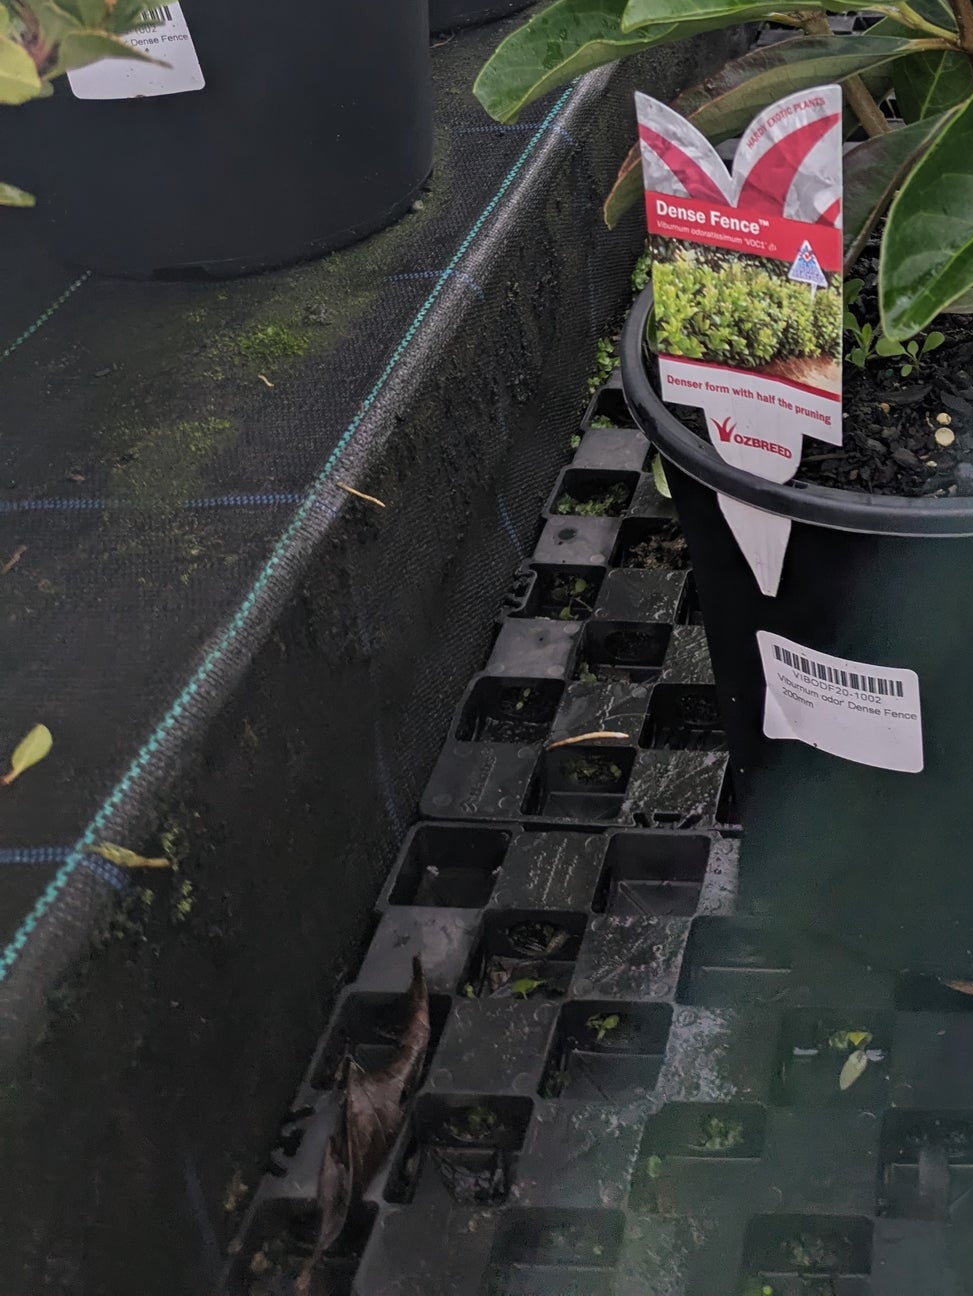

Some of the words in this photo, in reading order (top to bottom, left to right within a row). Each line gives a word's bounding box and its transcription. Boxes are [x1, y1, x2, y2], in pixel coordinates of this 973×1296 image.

[131, 38, 159, 47] Dense
[160, 34, 189, 43] Fence
[746, 124, 768, 150] HARDY
[766, 106, 793, 128] EXOTIC
[793, 97, 826, 112] PLANTS
[656, 199, 706, 224] Dense
[656, 220, 690, 234] Viburnum
[691, 228, 743, 244] odoratissimum
[667, 374, 702, 390] Denser
[705, 381, 730, 395] form
[732, 386, 754, 400] with
[756, 391, 776, 405] half
[777, 397, 793, 411] the
[795, 404, 832, 426] pruning
[733, 433, 793, 459] OZBREED
[777, 672, 819, 699] Viburnum
[847, 700, 881, 716] Dense
[884, 708, 918, 720] Fence
[782, 686, 814, 709] 200mm
